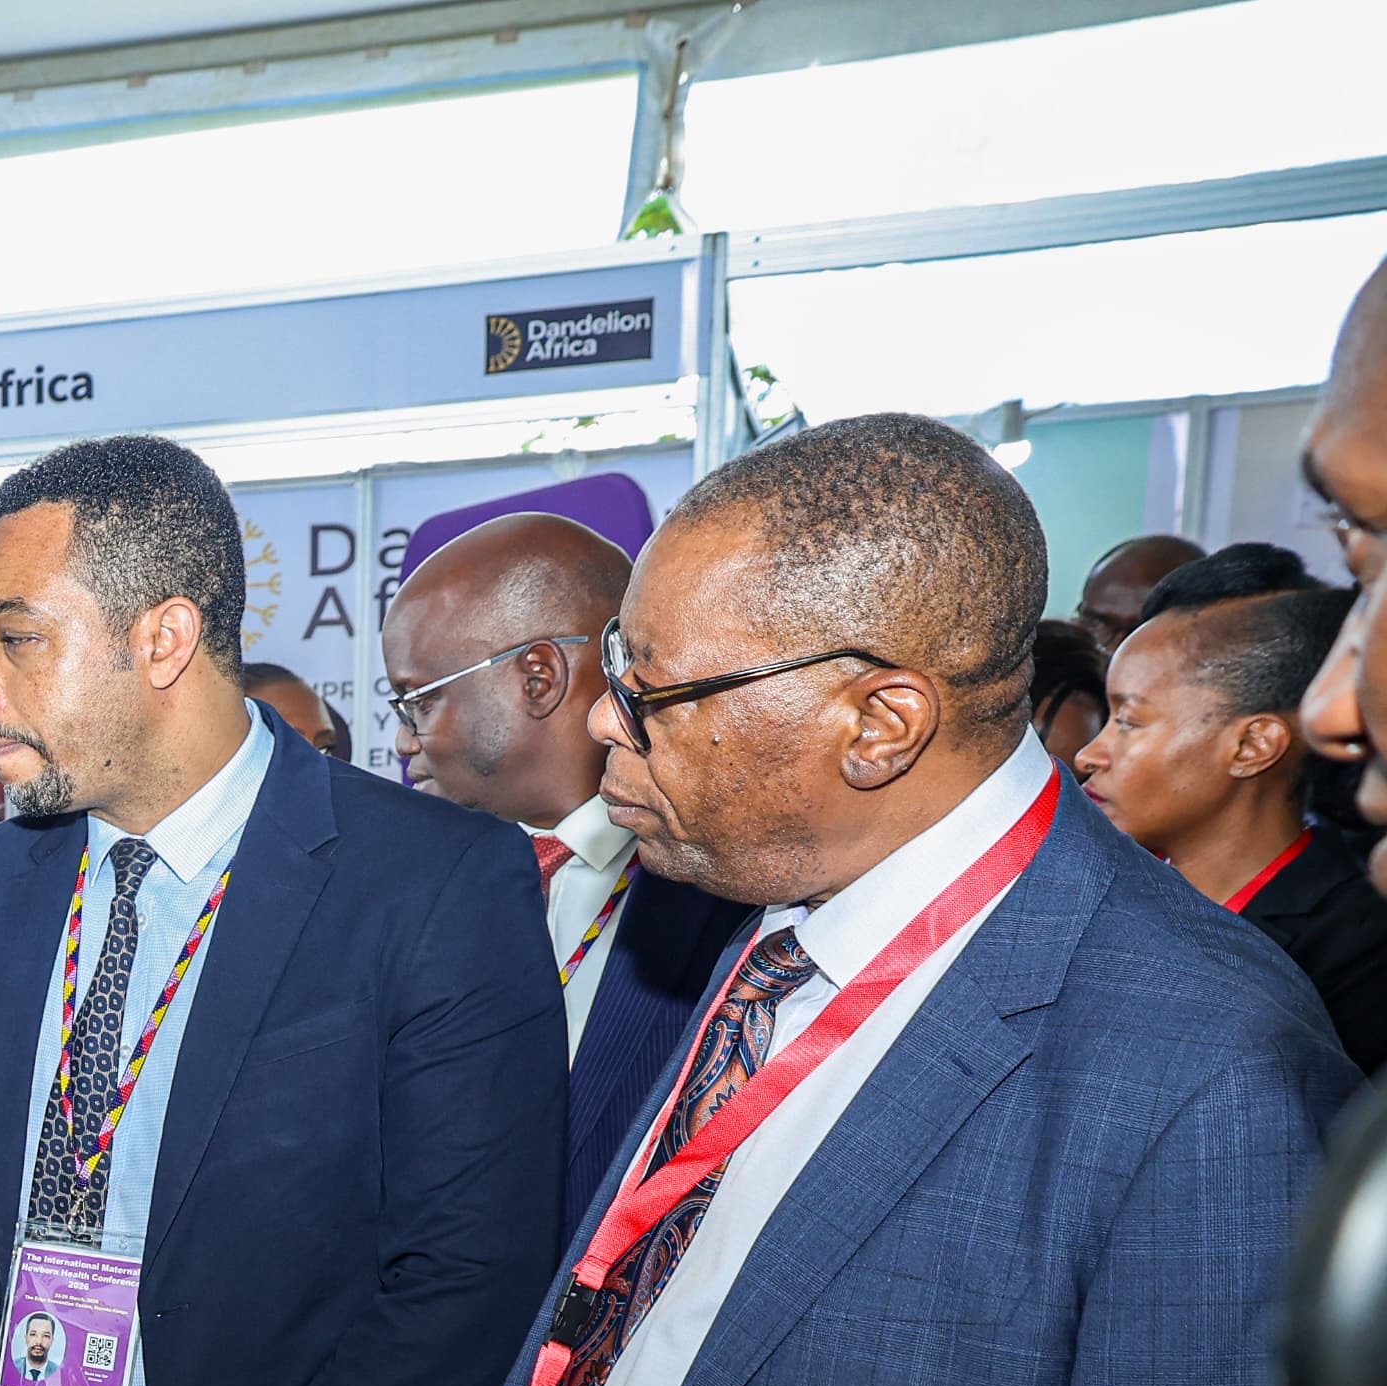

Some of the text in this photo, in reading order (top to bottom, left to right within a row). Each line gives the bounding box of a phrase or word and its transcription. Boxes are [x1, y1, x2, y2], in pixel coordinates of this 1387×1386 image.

[527, 308, 651, 341] Dandelion
[526, 336, 597, 363] Africa
[21, 1263, 59, 1275] Newborn
[60, 1269, 90, 1281] Health
[27, 1253, 141, 1276] The International Maternal
[67, 1281, 90, 1291] 2026
